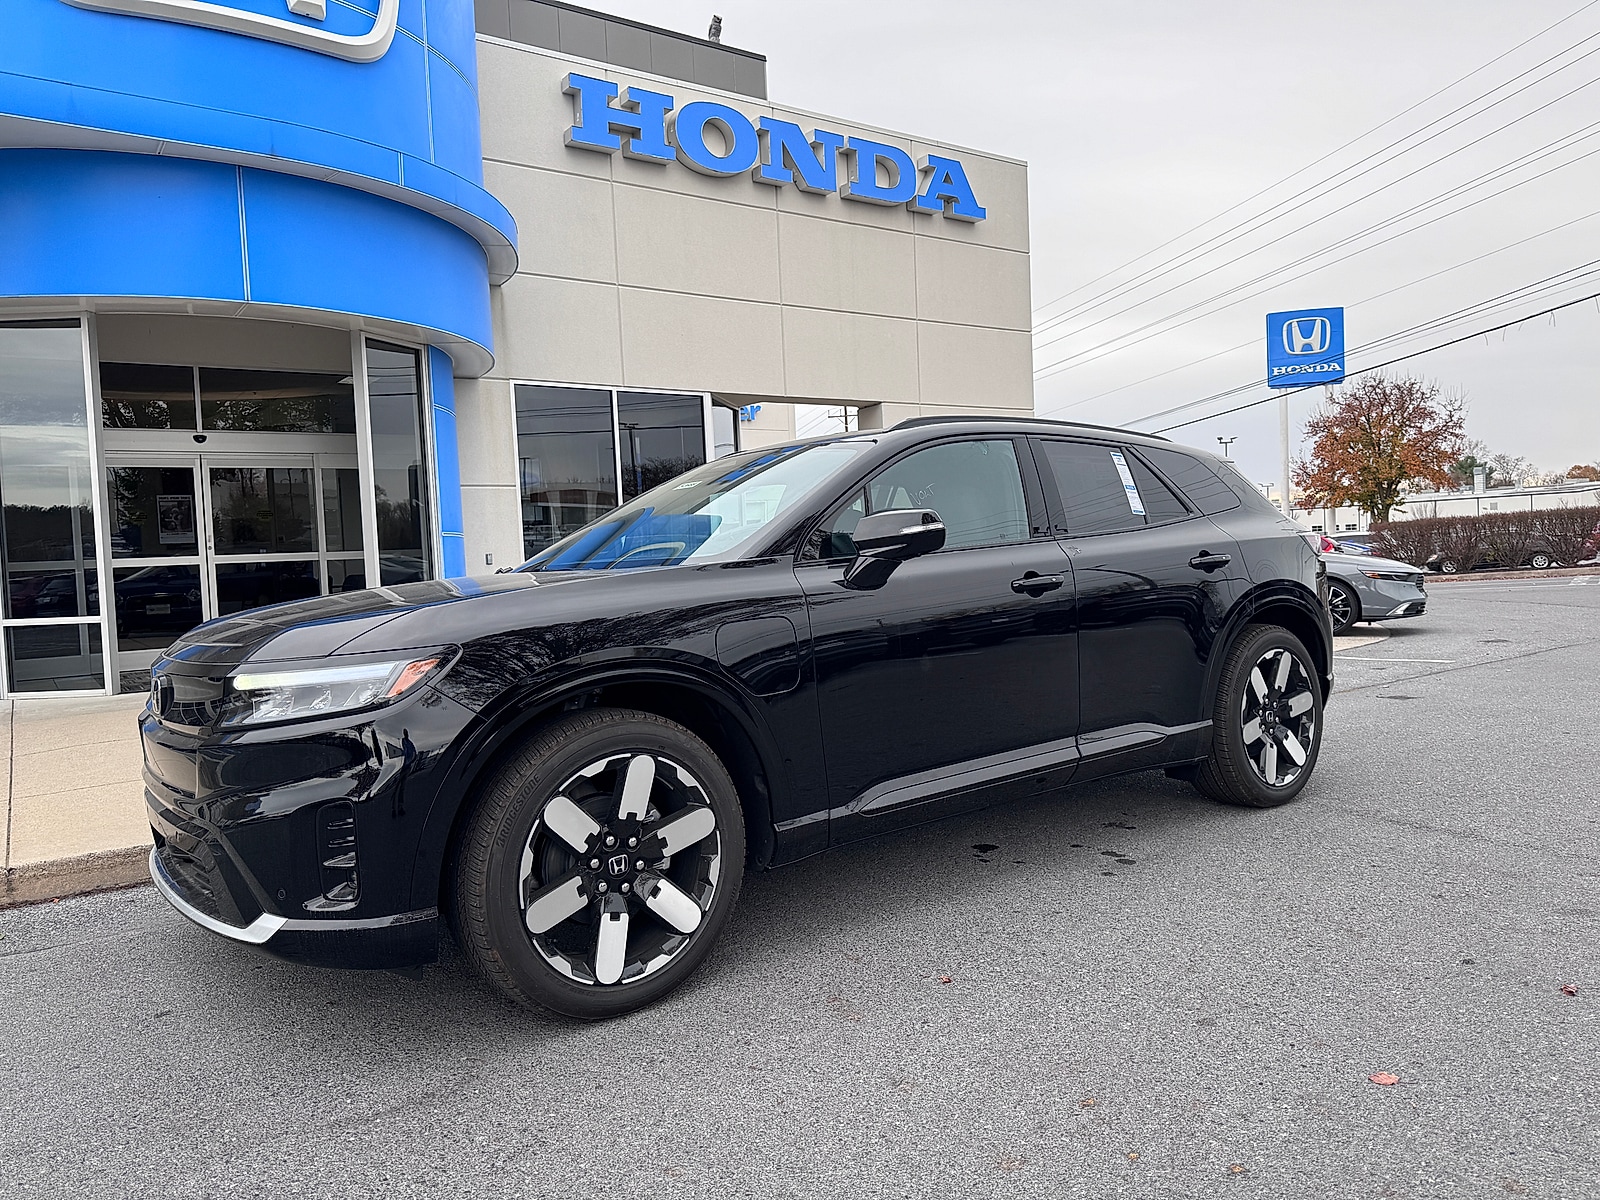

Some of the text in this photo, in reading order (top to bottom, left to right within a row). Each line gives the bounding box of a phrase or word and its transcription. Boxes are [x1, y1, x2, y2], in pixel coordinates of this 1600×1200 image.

[562, 72, 987, 223] HONDA
[1271, 362, 1342, 376] HONDA
[496, 774, 541, 848] BRIDGESTONE
